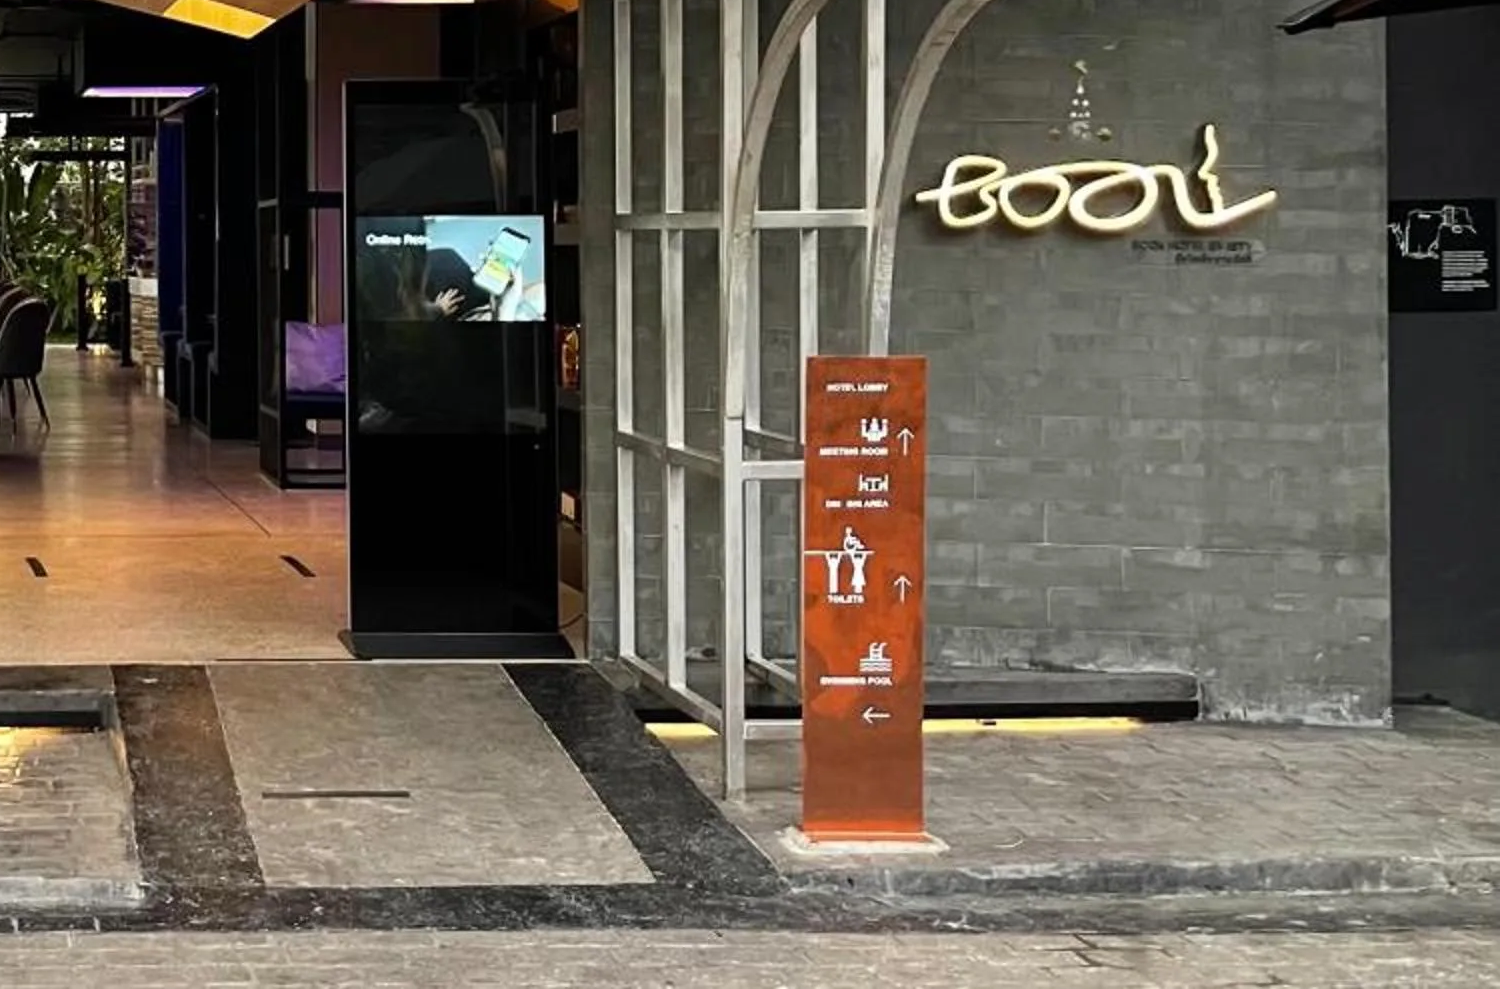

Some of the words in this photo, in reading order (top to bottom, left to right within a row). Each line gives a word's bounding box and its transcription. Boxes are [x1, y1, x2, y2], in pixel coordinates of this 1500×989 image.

[365, 233, 402, 246] Online
[826, 382, 857, 393] HOTEL
[857, 382, 889, 393] LOBBY
[860, 447, 889, 456] ROOM
[863, 499, 889, 509] AREA
[827, 594, 865, 604] TOILETS
[867, 676, 893, 686] POOL
